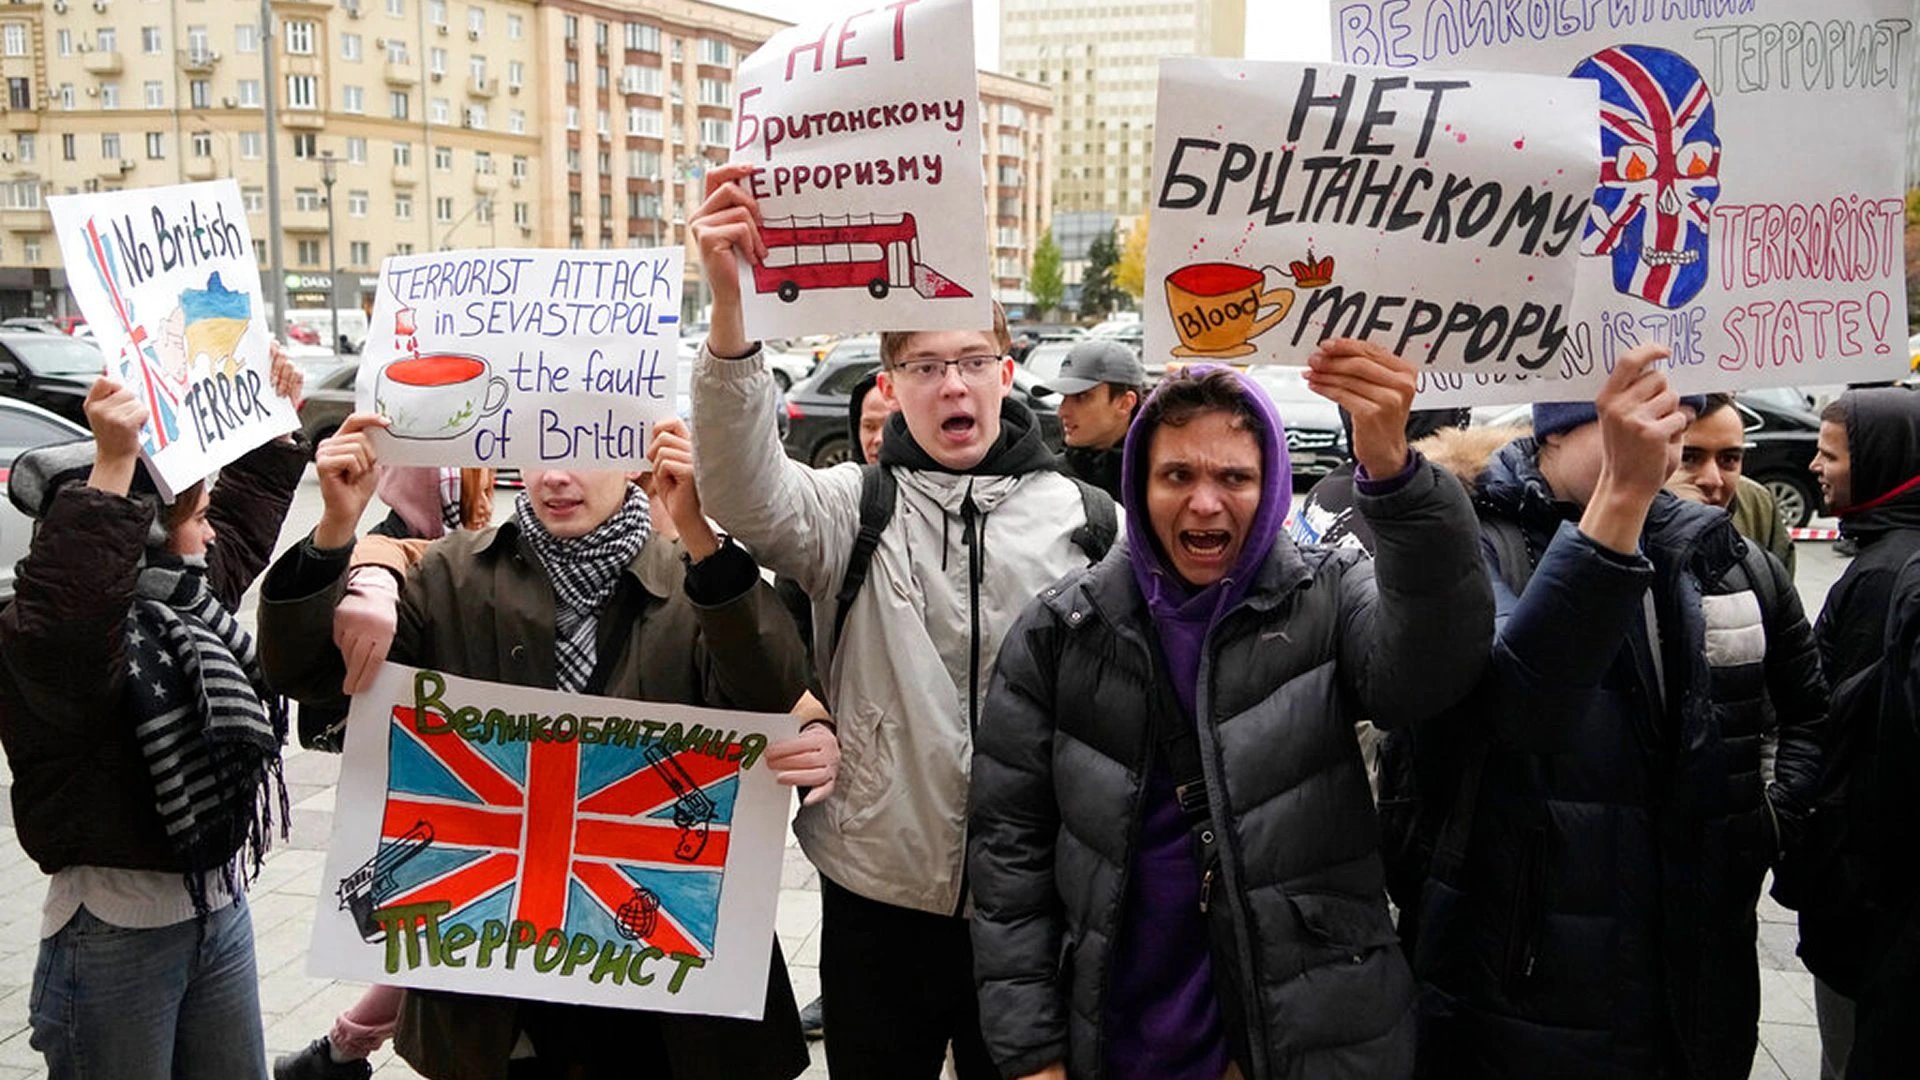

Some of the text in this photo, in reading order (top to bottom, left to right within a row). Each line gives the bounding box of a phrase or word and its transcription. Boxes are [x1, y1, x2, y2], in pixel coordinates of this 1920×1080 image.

[785, 0, 920, 80] НЕТ
[1695, 19, 1912, 97] ТЕРРОРИСТ
[735, 87, 965, 161] Британскому
[1287, 67, 1472, 159] НЕТ
[748, 154, 943, 200] ЕРРОРИЗМУ
[112, 200, 243, 287] No British
[388, 258, 671, 300] TERRORIST ATTACK
[434, 310, 455, 335] in
[1178, 291, 1260, 340] Blood
[1640, 306, 1707, 370] THE
[1718, 290, 1891, 371] STATE!
[184, 369, 272, 454] TERROR
[508, 350, 667, 399] the fault
[475, 408, 645, 461] of Britai
